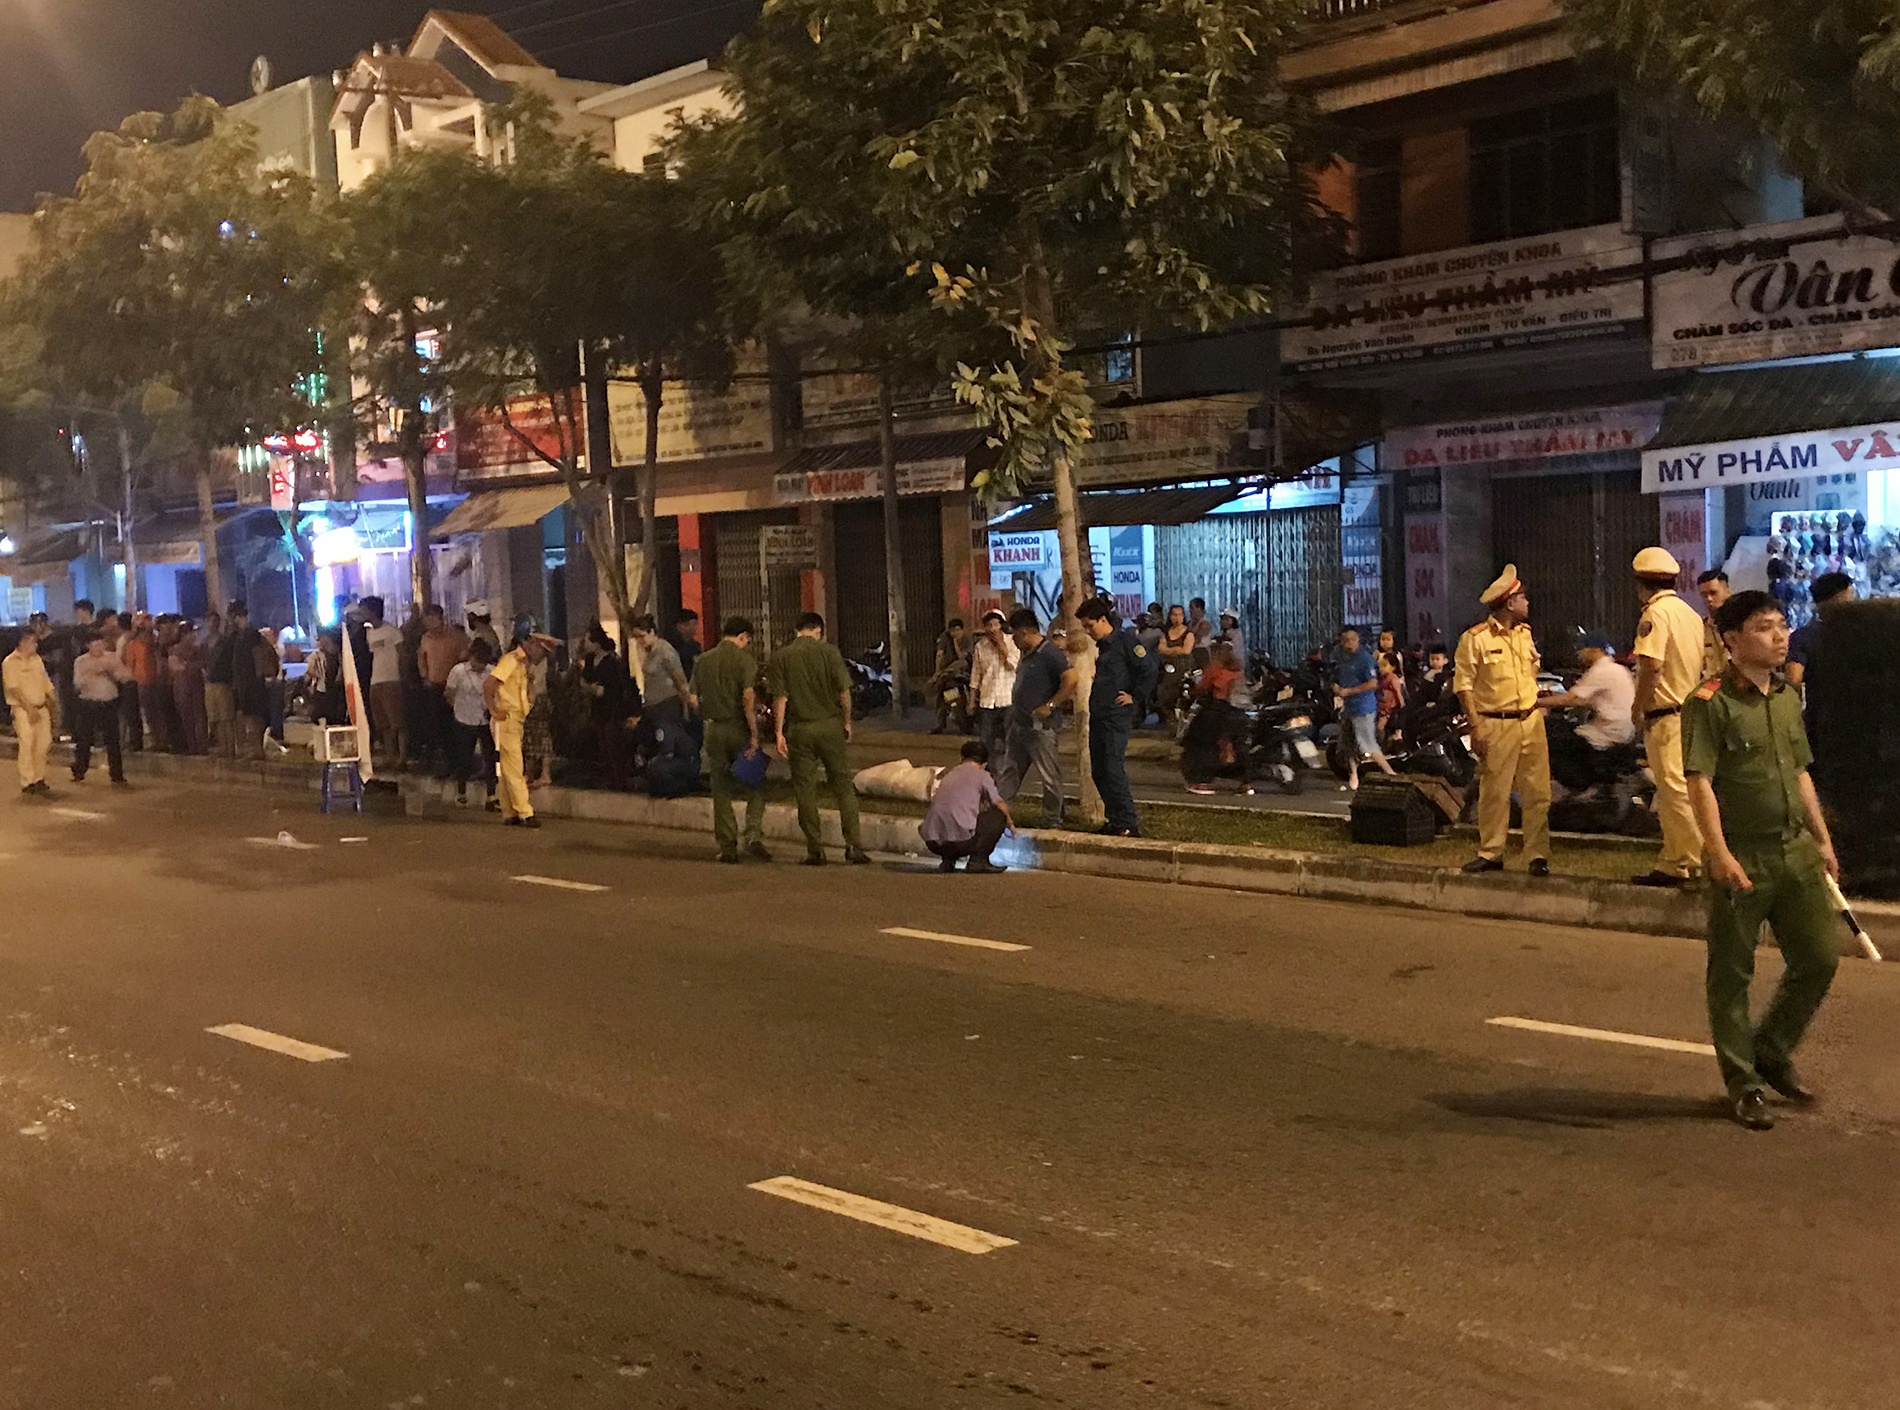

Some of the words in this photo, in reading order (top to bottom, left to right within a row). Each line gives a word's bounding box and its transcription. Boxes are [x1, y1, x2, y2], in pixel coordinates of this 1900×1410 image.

[1515, 242, 1562, 262] KHOA
[1731, 259, 1879, 314] Vân
[1728, 318, 1764, 335] SÓC
[1658, 452, 1706, 483] MỸ
[1717, 440, 1819, 477] PHẨM
[1832, 429, 1900, 462] VÂ
[1007, 536, 1040, 546] HONDA
[993, 547, 1041, 563] KHANH
[1113, 570, 1141, 584] HONDA
